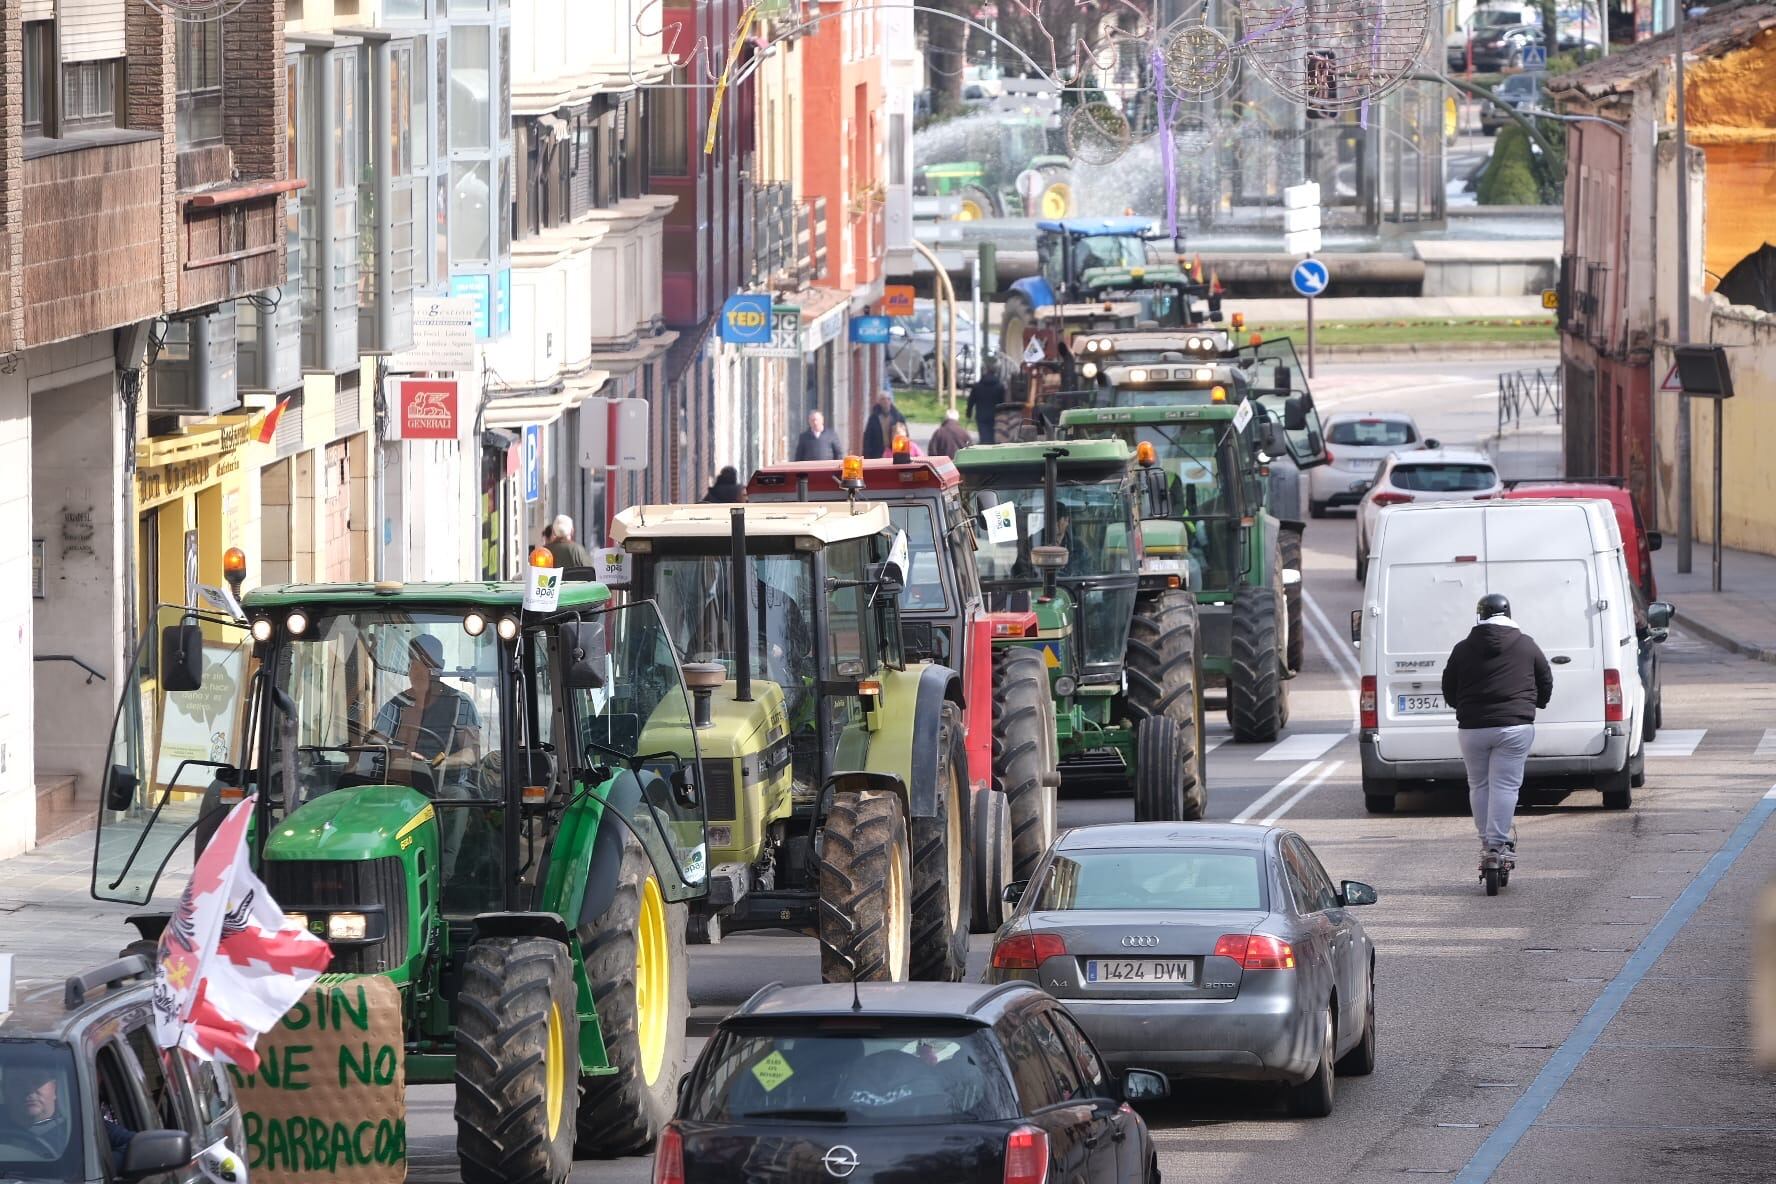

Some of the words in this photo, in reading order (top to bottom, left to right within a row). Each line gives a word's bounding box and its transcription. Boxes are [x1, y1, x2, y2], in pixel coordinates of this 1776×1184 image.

[407, 419, 451, 430] GENERALI
[1395, 660, 1436, 668] TRANSIT
[1408, 697, 1439, 710] 3354
[1103, 963, 1145, 980] 1424
[1154, 962, 1188, 980] DVM
[338, 1041, 397, 1088] NO
